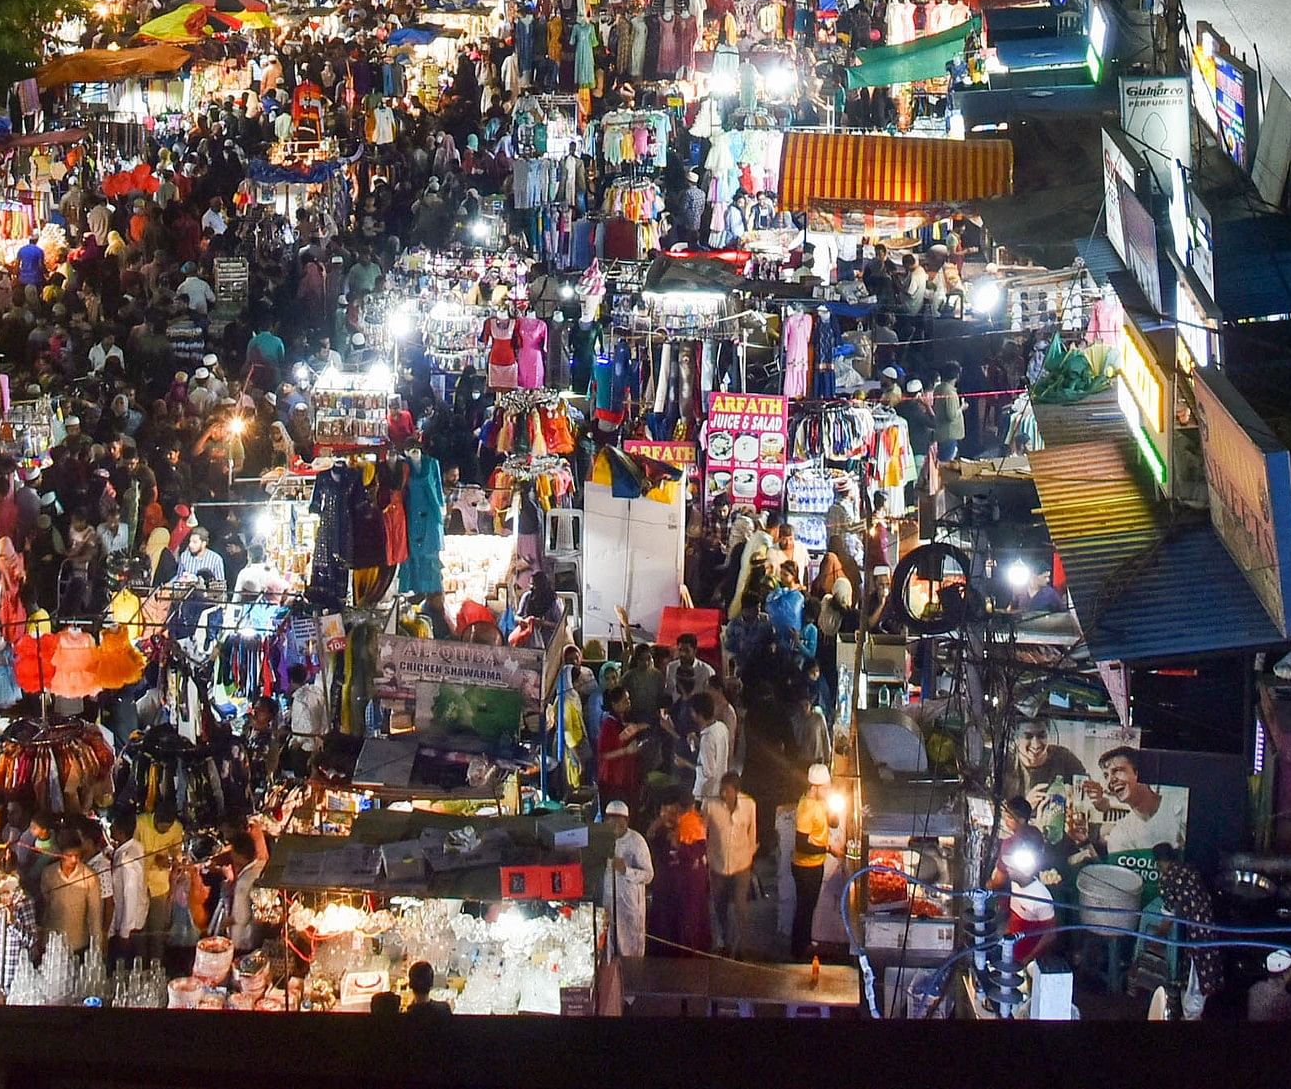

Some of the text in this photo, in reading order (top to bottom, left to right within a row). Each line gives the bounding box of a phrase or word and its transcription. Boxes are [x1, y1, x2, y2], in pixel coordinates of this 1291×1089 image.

[1128, 99, 1184, 108] PERFUMERS
[711, 395, 783, 415] ARFATH
[710, 413, 740, 429] JUICE
[752, 415, 783, 431] SALAD
[399, 662, 502, 681] CHICKEN SHAWARMA
